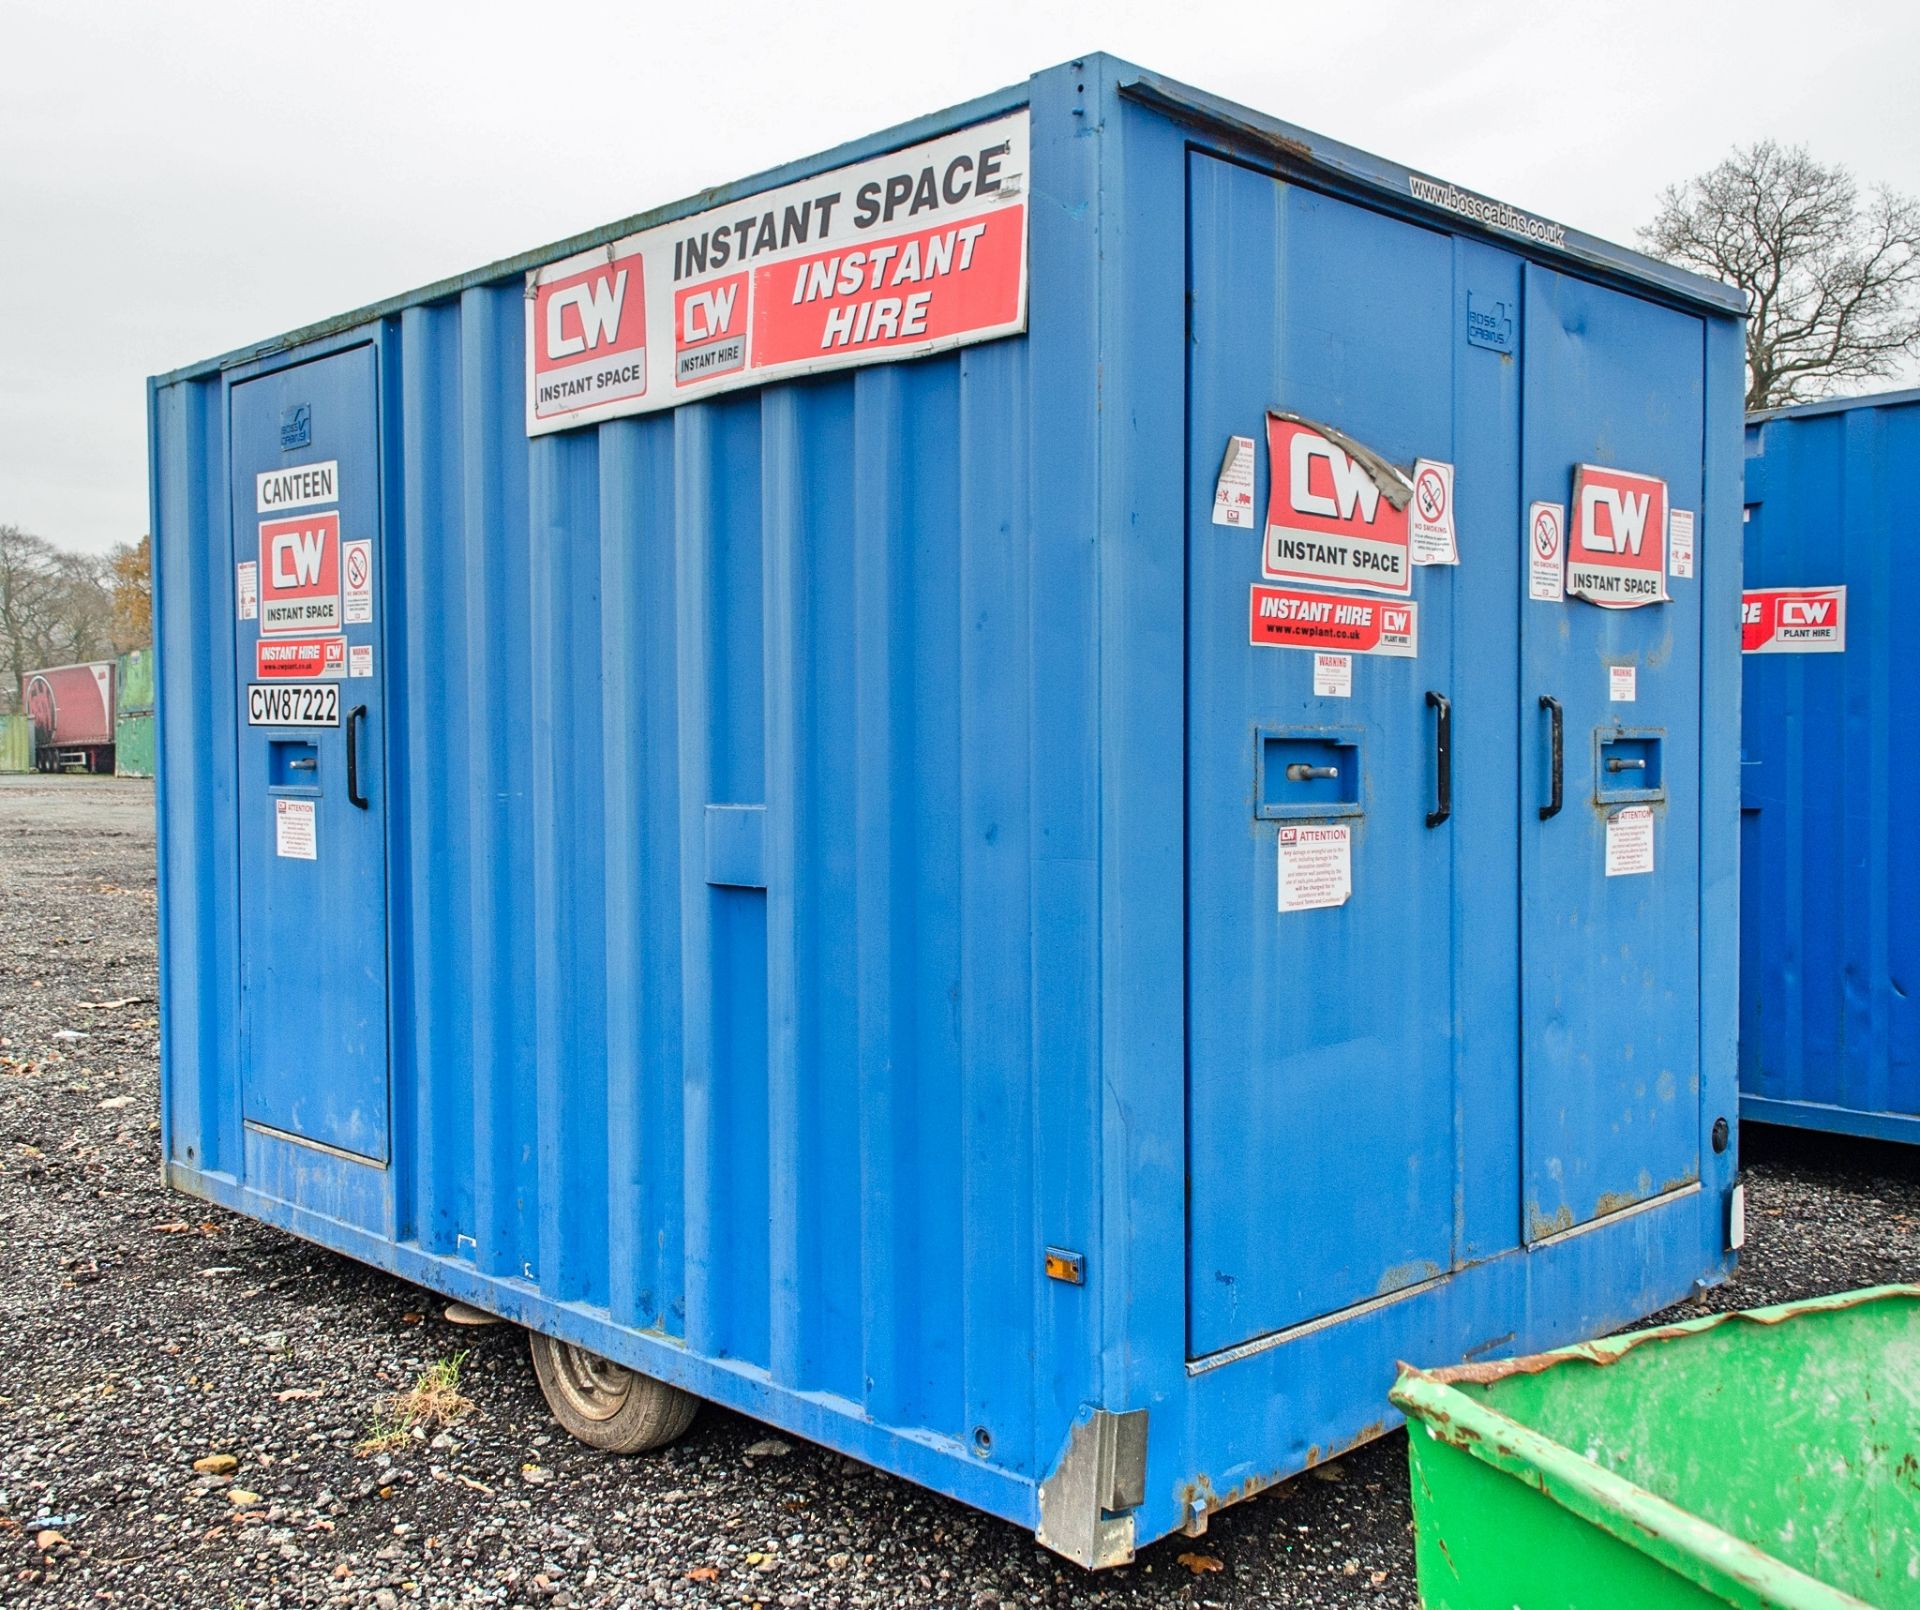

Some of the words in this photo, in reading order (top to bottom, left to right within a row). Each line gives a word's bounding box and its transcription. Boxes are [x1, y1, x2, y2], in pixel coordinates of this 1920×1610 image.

[674, 193, 841, 282] INSTANT
[853, 143, 1005, 230] SPACE
[1410, 176, 1565, 246] www.bosscabins.co.uk
[793, 224, 987, 304] INSTANT
[547, 269, 630, 360] CW
[683, 283, 738, 344] CW
[820, 291, 932, 349] HIRE
[1469, 312, 1496, 327] BOSS
[1469, 326, 1505, 344] CABINS
[680, 351, 716, 374] INSTANT
[717, 345, 739, 366] HIRE
[539, 376, 592, 403] INSTANT
[596, 363, 640, 390] SPACE
[262, 469, 332, 505] CANTEEN
[1290, 432, 1381, 525] CW
[1423, 524, 1448, 534] SMOKING
[1581, 484, 1651, 556] CW
[271, 528, 327, 589] CW
[1277, 538, 1348, 566] INSTANT
[1352, 550, 1400, 573] SPACE
[1573, 573, 1621, 593] INSTANT
[1624, 578, 1657, 595] SPACE
[267, 606, 303, 622] INSTANT
[306, 604, 334, 619] SPACE
[1259, 597, 1333, 624] INSTANT
[1334, 605, 1374, 627] HIRE
[1383, 611, 1408, 632] CW
[1783, 602, 1831, 624] CW
[1266, 624, 1361, 640] www.cwplant.co.uk
[1384, 635, 1398, 643] PLANT
[1784, 630, 1810, 638] PLANT
[1812, 629, 1831, 637] HIRE
[261, 646, 298, 661] INSTANT
[298, 644, 320, 660] HIRE
[326, 645, 341, 660] CW
[1318, 656, 1348, 668] WARNING
[251, 688, 337, 721] CW87222
[1299, 830, 1347, 842] ATTENTION
